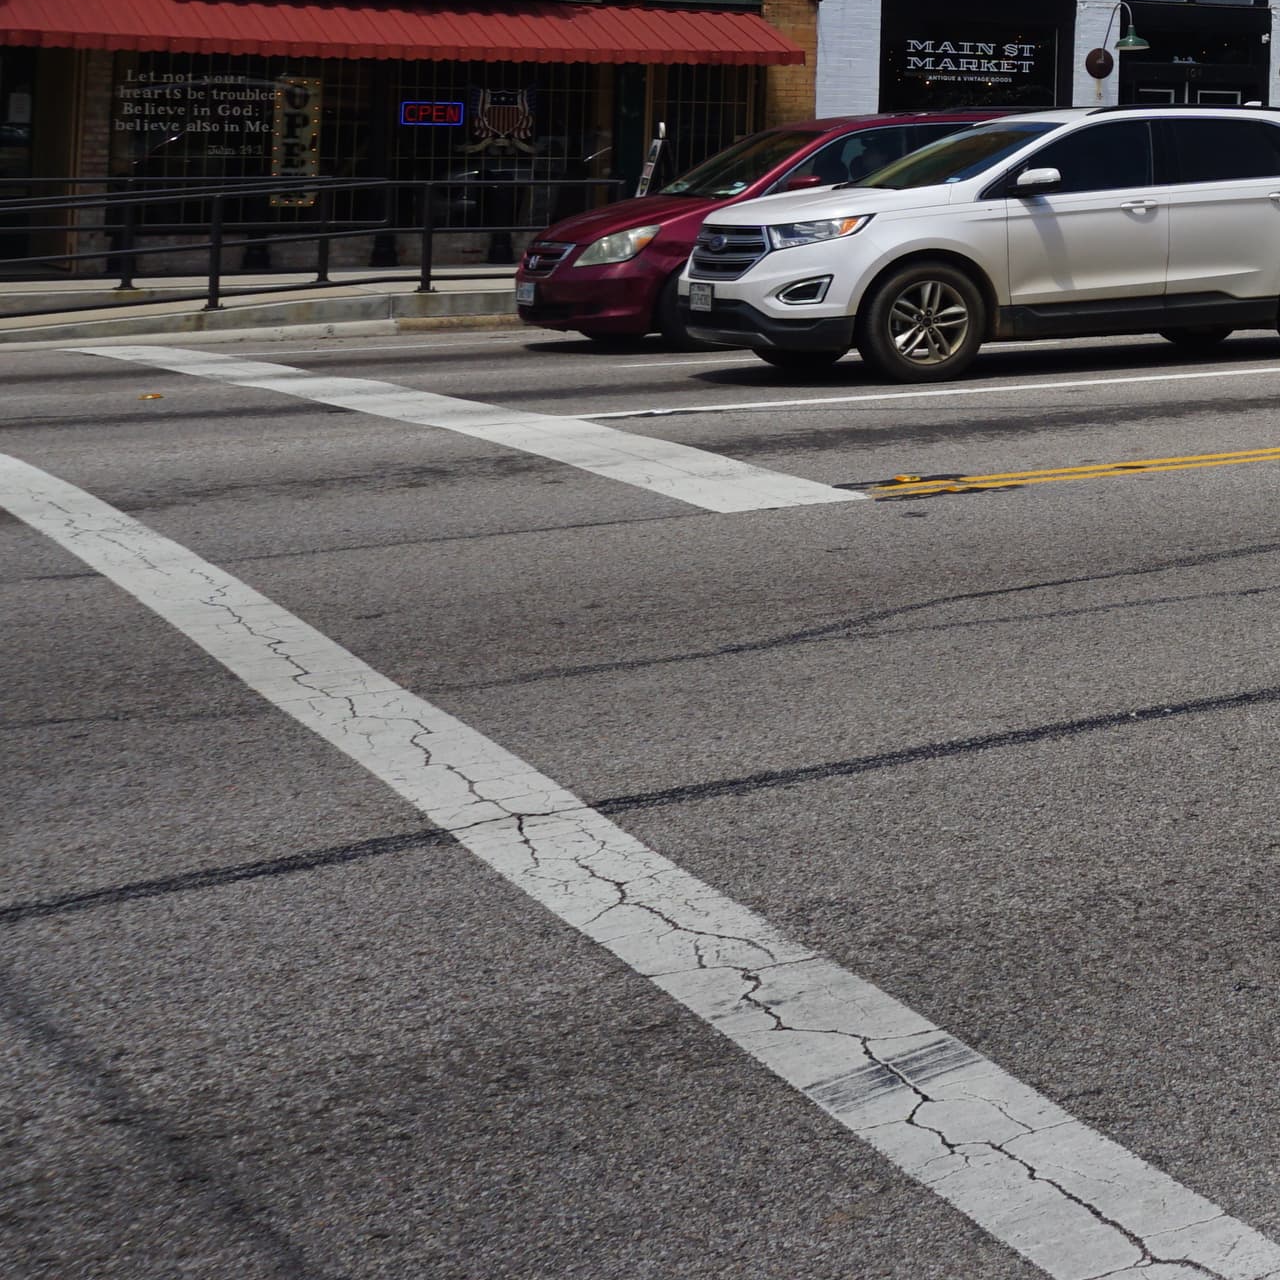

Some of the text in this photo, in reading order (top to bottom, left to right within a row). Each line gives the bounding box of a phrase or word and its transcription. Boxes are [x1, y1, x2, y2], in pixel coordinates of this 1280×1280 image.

[906, 40, 996, 55] MAIN
[906, 57, 1035, 73] MARKET
[127, 69, 246, 86] Let not your
[119, 86, 182, 99] hearts
[188, 86, 208, 100] be
[123, 102, 185, 115] Believe
[193, 103, 211, 115] in
[405, 105, 460, 122] OPEN
[114, 119, 180, 132] believe
[186, 120, 220, 133] also
[223, 120, 240, 133] in
